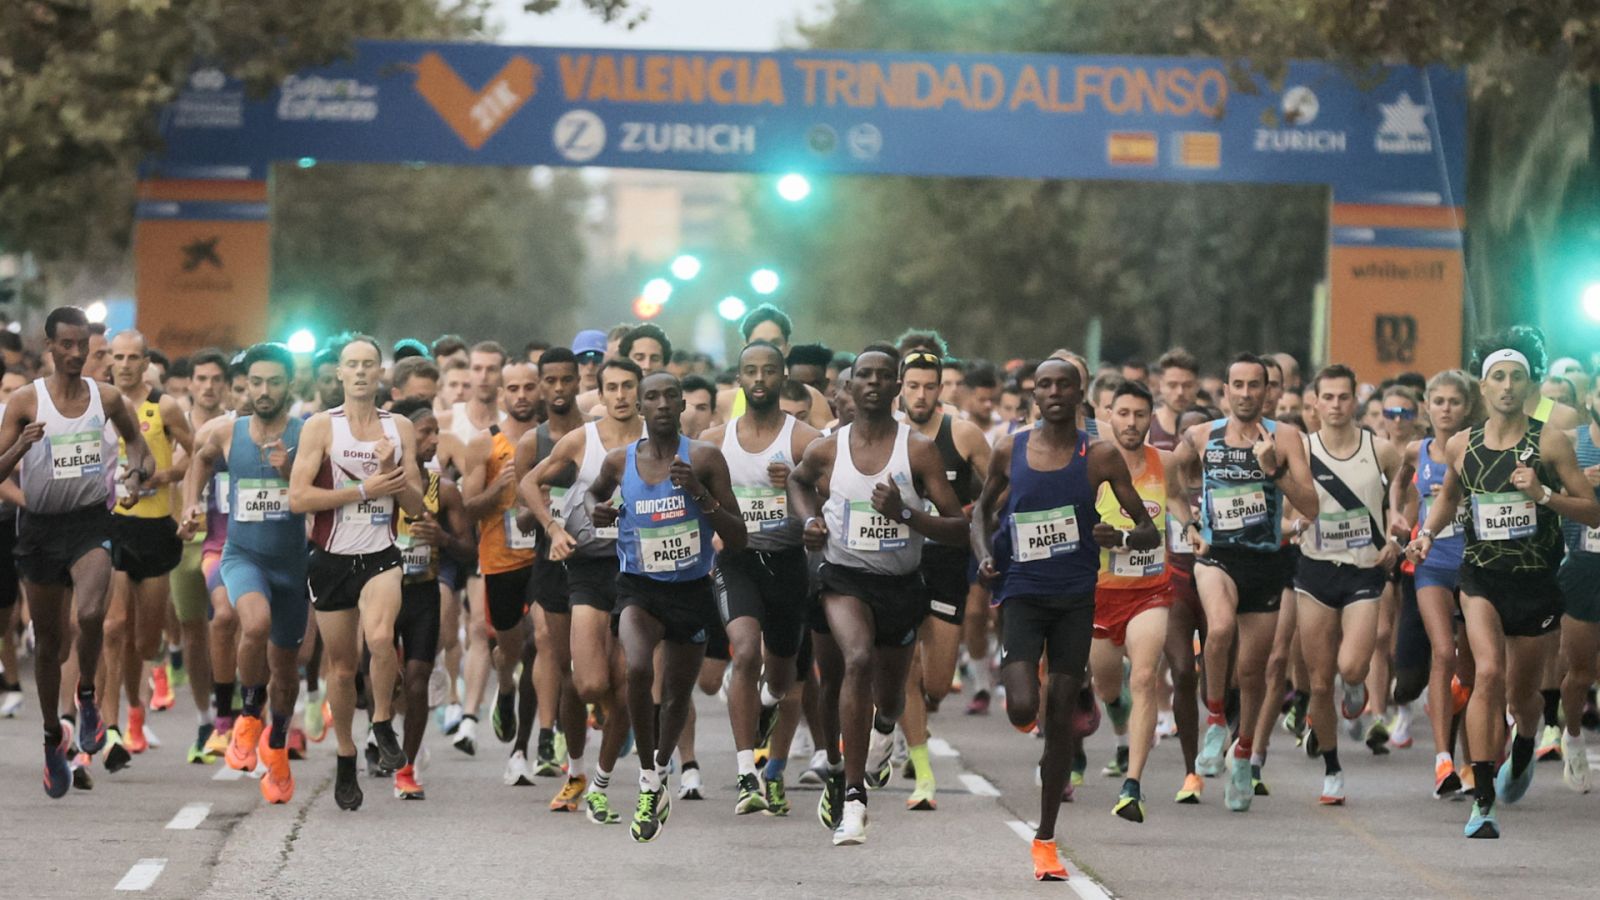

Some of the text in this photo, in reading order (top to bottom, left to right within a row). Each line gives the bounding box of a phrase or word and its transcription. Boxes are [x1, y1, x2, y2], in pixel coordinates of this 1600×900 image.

[557, 54, 1228, 118] VALENCIA TRINIDAD ALFONSO
[620, 121, 756, 155] ZURICH
[1254, 128, 1347, 153] ZURICH
[76, 445, 82, 454] 6
[53, 452, 101, 468] KEJELCHA
[256, 491, 269, 500] 47
[245, 500, 281, 512] CARRO
[635, 495, 685, 516] RUNCZECH
[751, 500, 764, 510] 28
[1231, 497, 1244, 507] 86
[660, 509, 685, 519] RACING
[1499, 505, 1513, 515] 37
[870, 516, 890, 526] 113
[1338, 520, 1350, 530] 68
[1485, 514, 1530, 528] BLANCO
[859, 526, 899, 539] PACER
[1035, 523, 1056, 534] 111
[661, 537, 682, 549] 110
[1028, 532, 1068, 548] PACER
[653, 547, 691, 562] PACER
